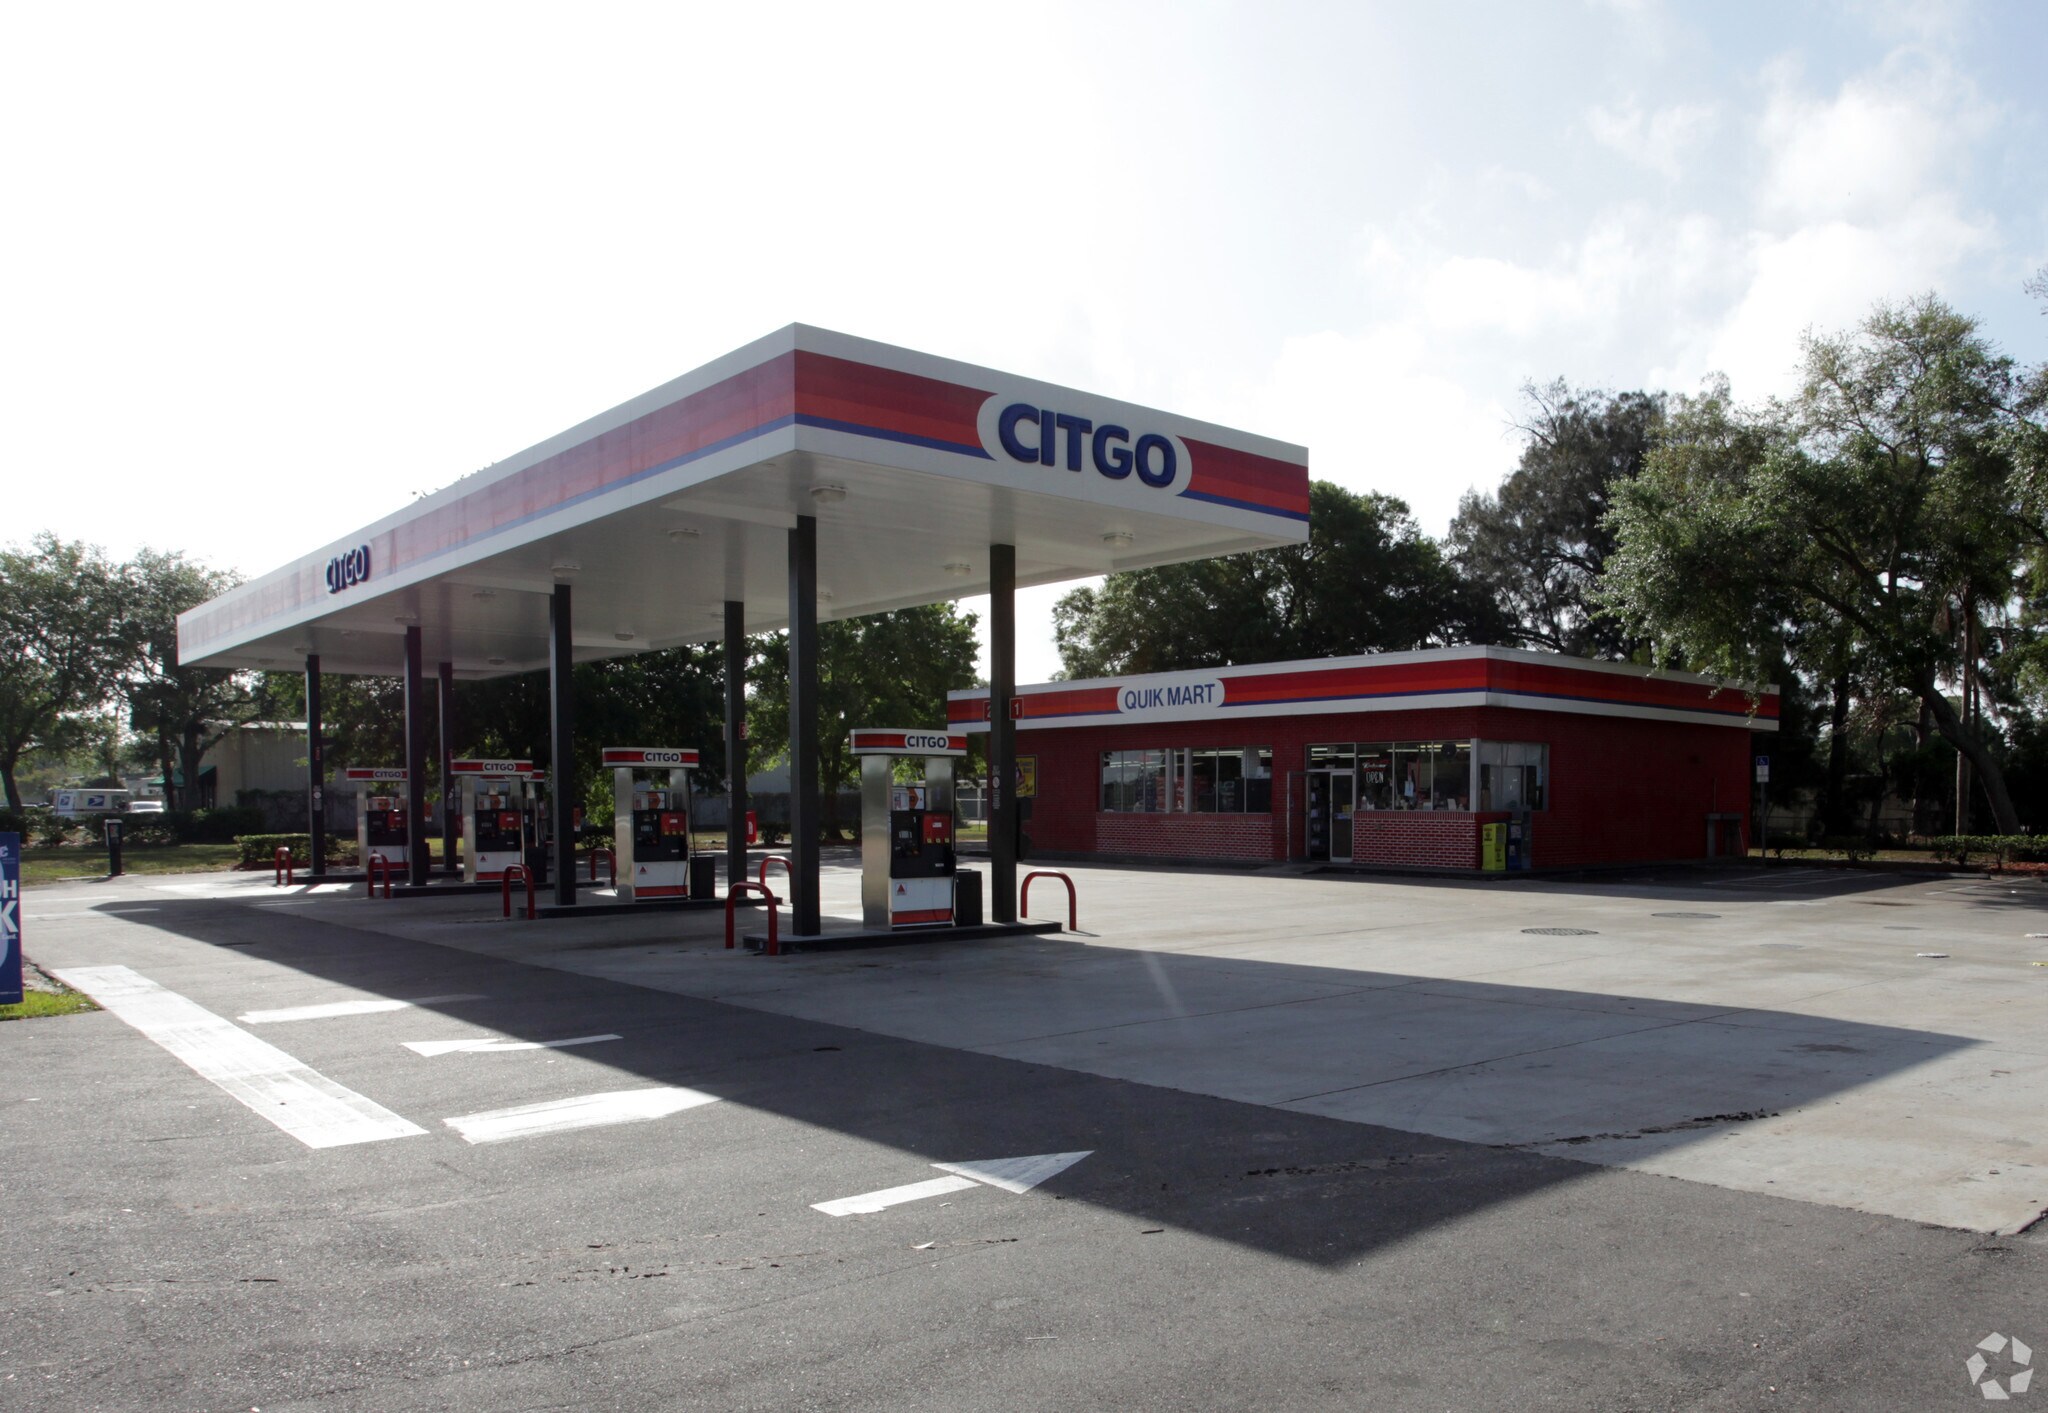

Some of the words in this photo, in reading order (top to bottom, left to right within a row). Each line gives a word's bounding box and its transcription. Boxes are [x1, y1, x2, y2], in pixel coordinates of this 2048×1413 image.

[998, 403, 1177, 489] CITGO
[325, 544, 370, 595] CITGO
[1125, 688, 1164, 710] QUIK
[1168, 683, 1216, 706] MART
[1014, 702, 1020, 716] 1
[907, 735, 947, 748] CITGO
[645, 752, 680, 762] CITGO
[484, 763, 515, 771] CITGO
[374, 770, 402, 778] CITGO
[1366, 771, 1384, 784] OPEN
